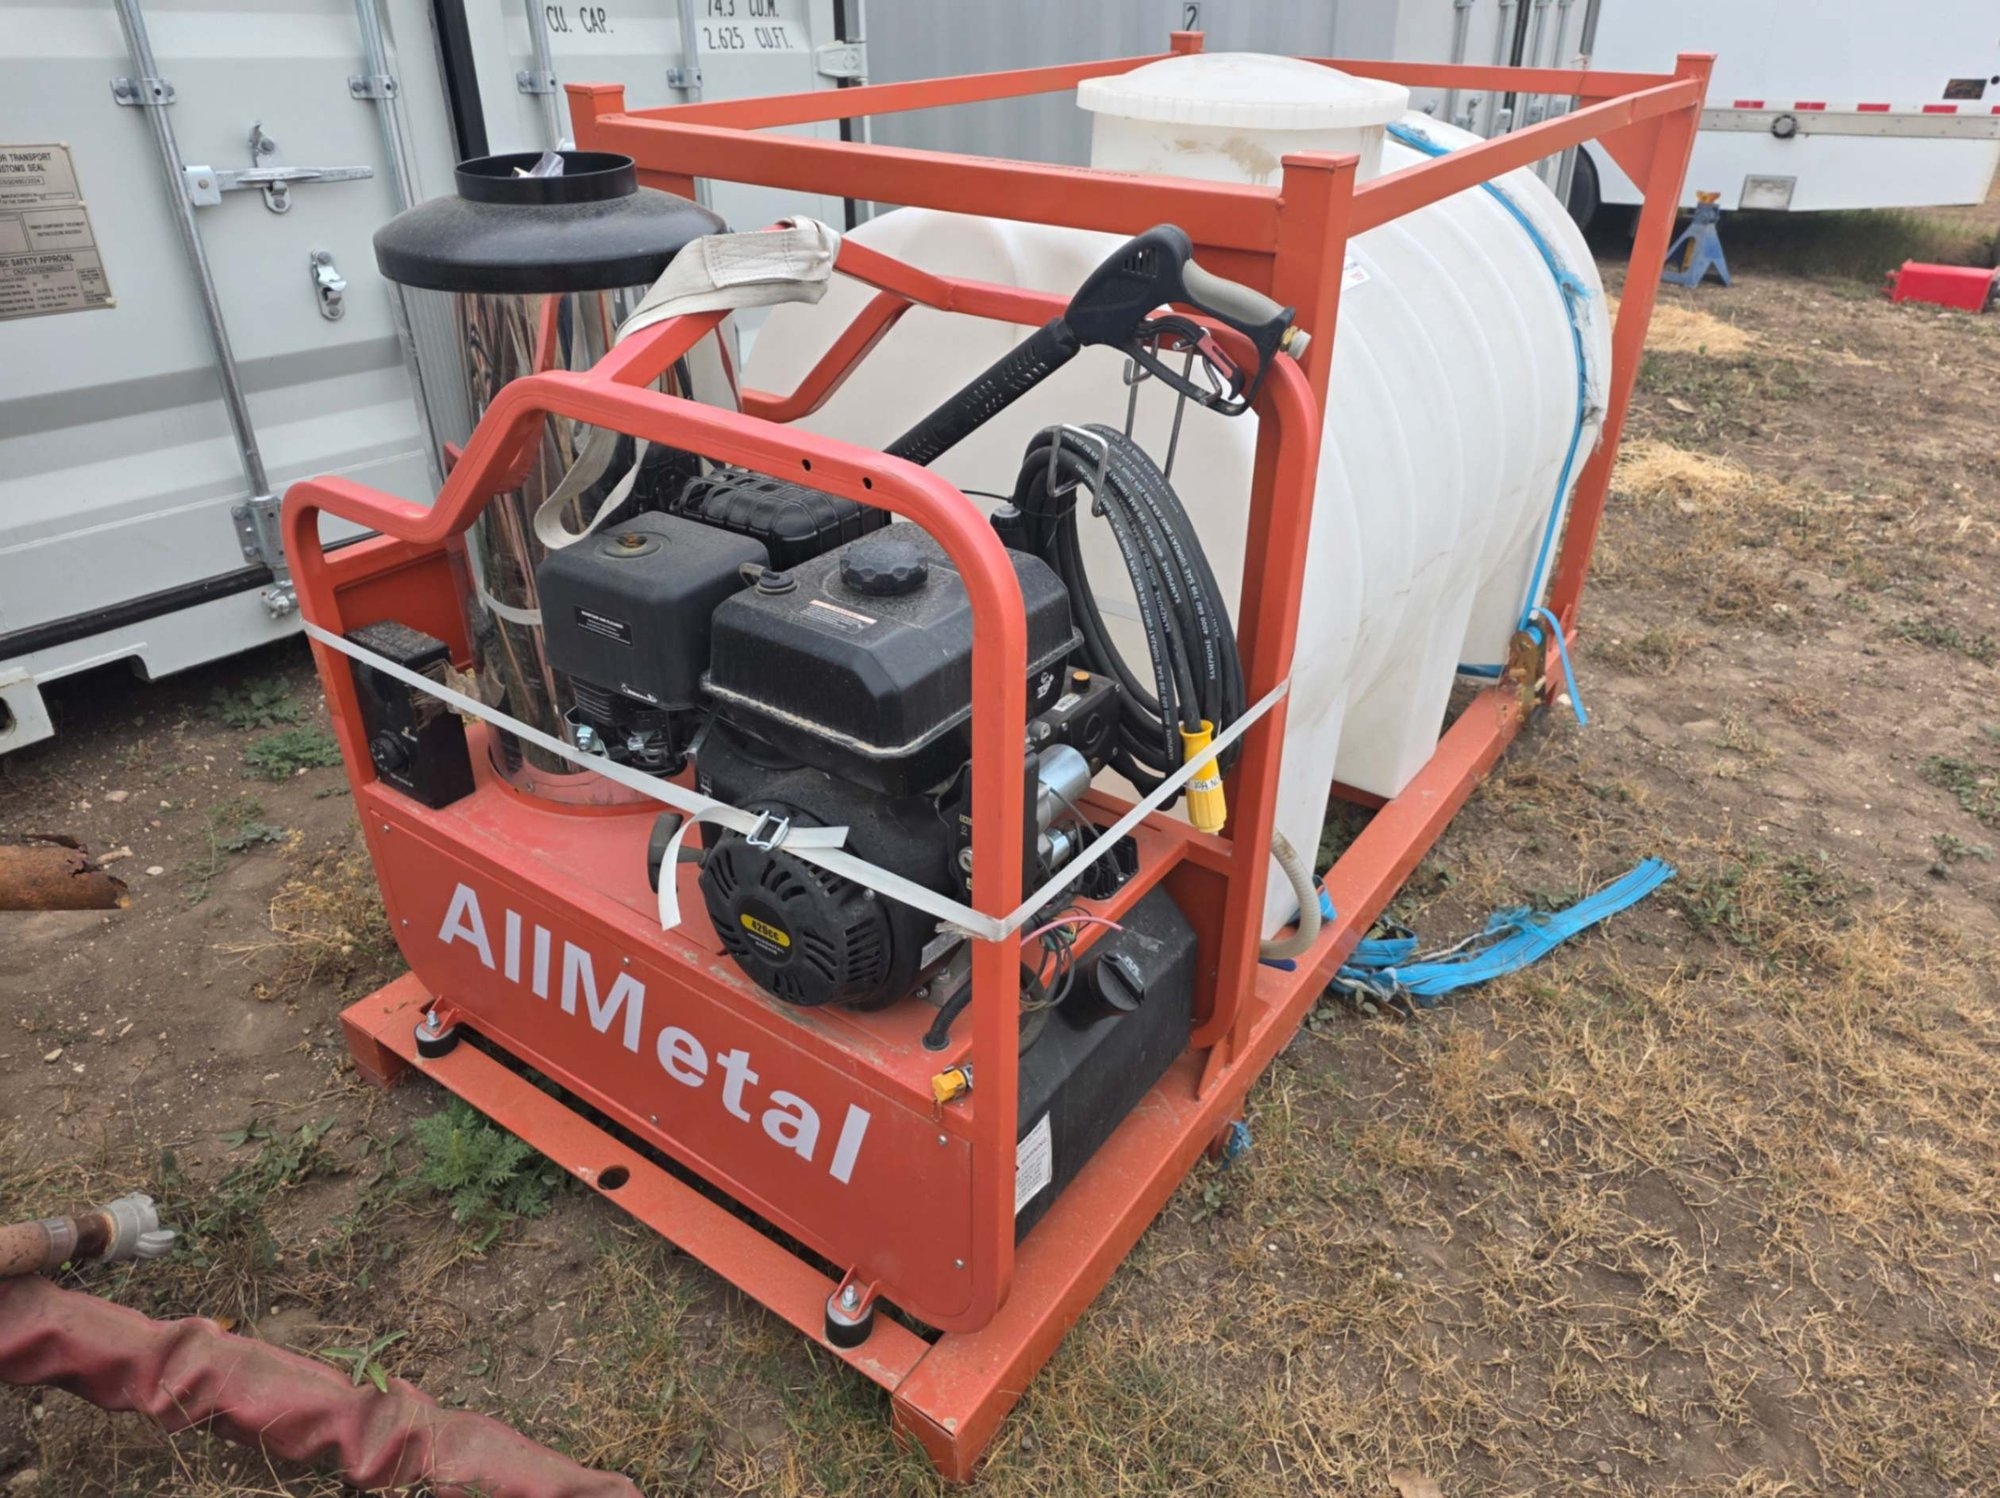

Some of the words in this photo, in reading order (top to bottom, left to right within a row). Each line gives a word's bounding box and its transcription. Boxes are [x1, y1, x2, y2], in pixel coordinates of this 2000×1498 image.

[546, 5, 573, 33] CU.
[580, 6, 614, 34] CAP.
[703, 26, 745, 50] 2.625
[9, 152, 51, 162] TRANSPORT
[0, 163, 26, 173] STOMS
[27, 162, 46, 172] SEAL
[11, 256, 38, 266] SAFETY
[39, 253, 75, 262] APPROVAL
[438, 882, 871, 1185] AllMetal
